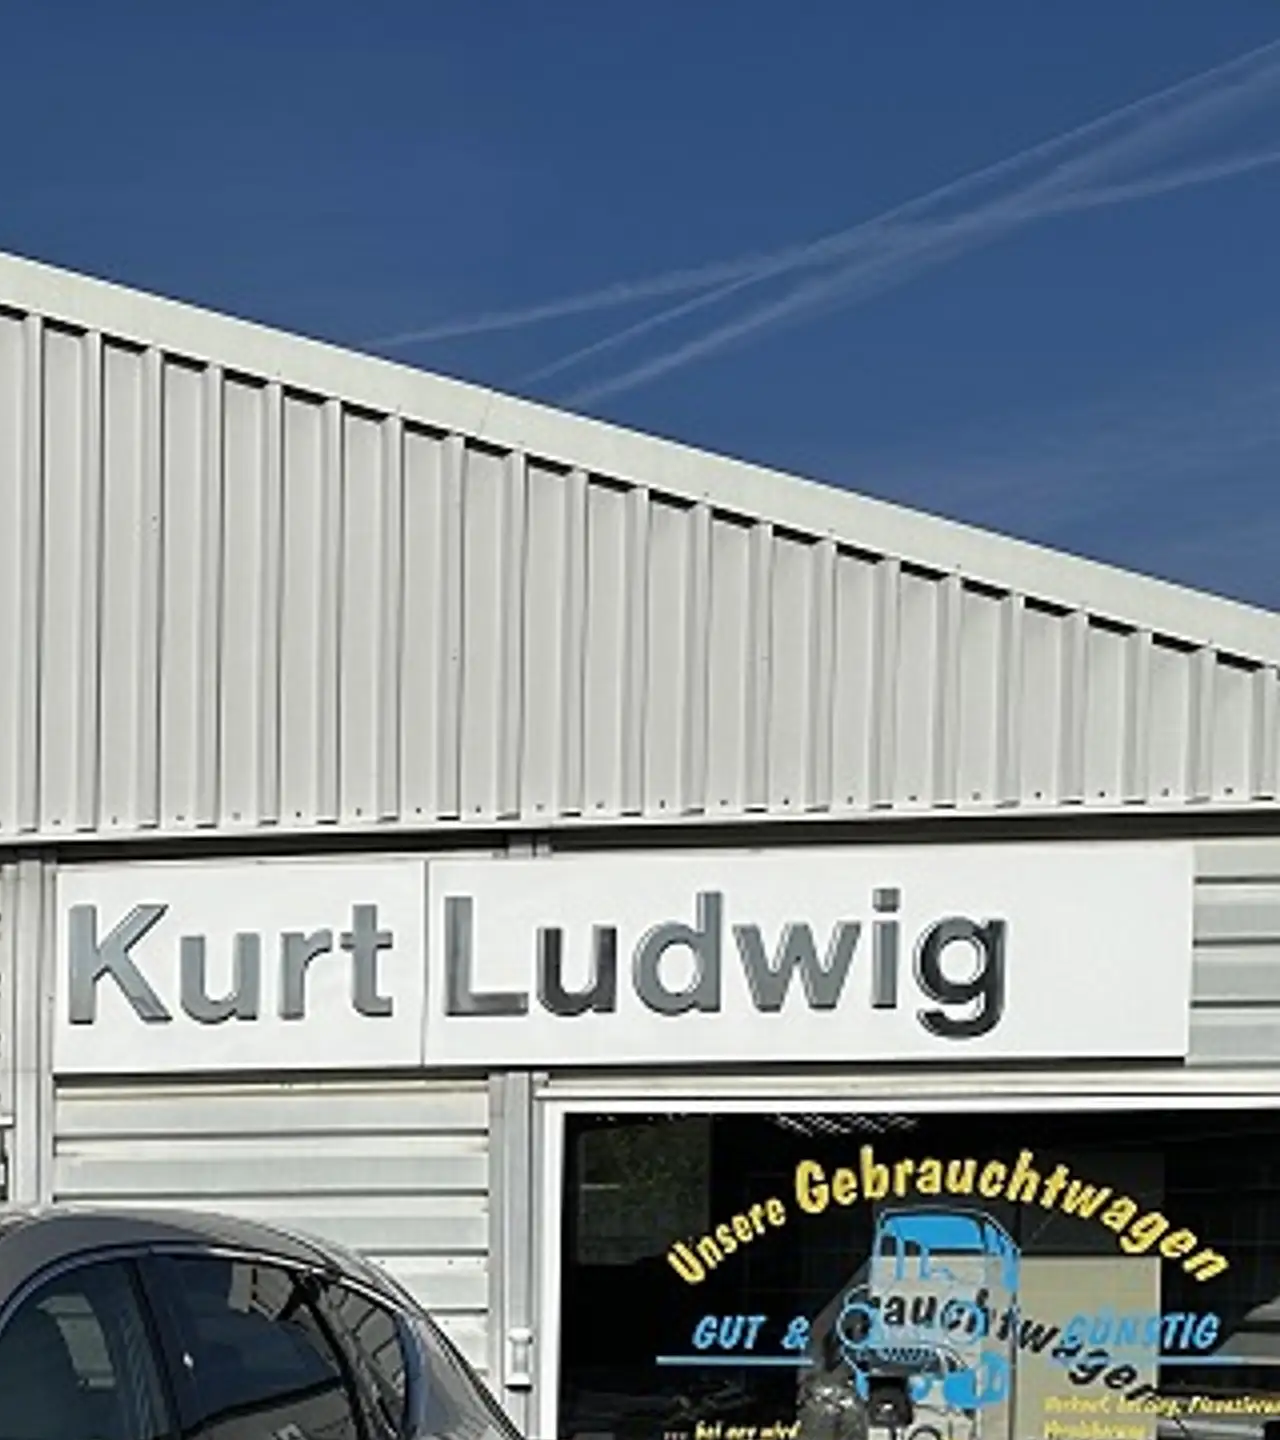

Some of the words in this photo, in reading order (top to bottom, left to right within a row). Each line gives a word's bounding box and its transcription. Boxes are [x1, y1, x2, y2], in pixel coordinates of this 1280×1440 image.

[66, 902, 394, 1025] Kurt
[442, 888, 1008, 1040] Ludwig
[667, 1197, 787, 1285] Unsere
[794, 1145, 1231, 1283] Gebrauchtwagen
[692, 1315, 767, 1350] GUT
[780, 1315, 811, 1350] &
